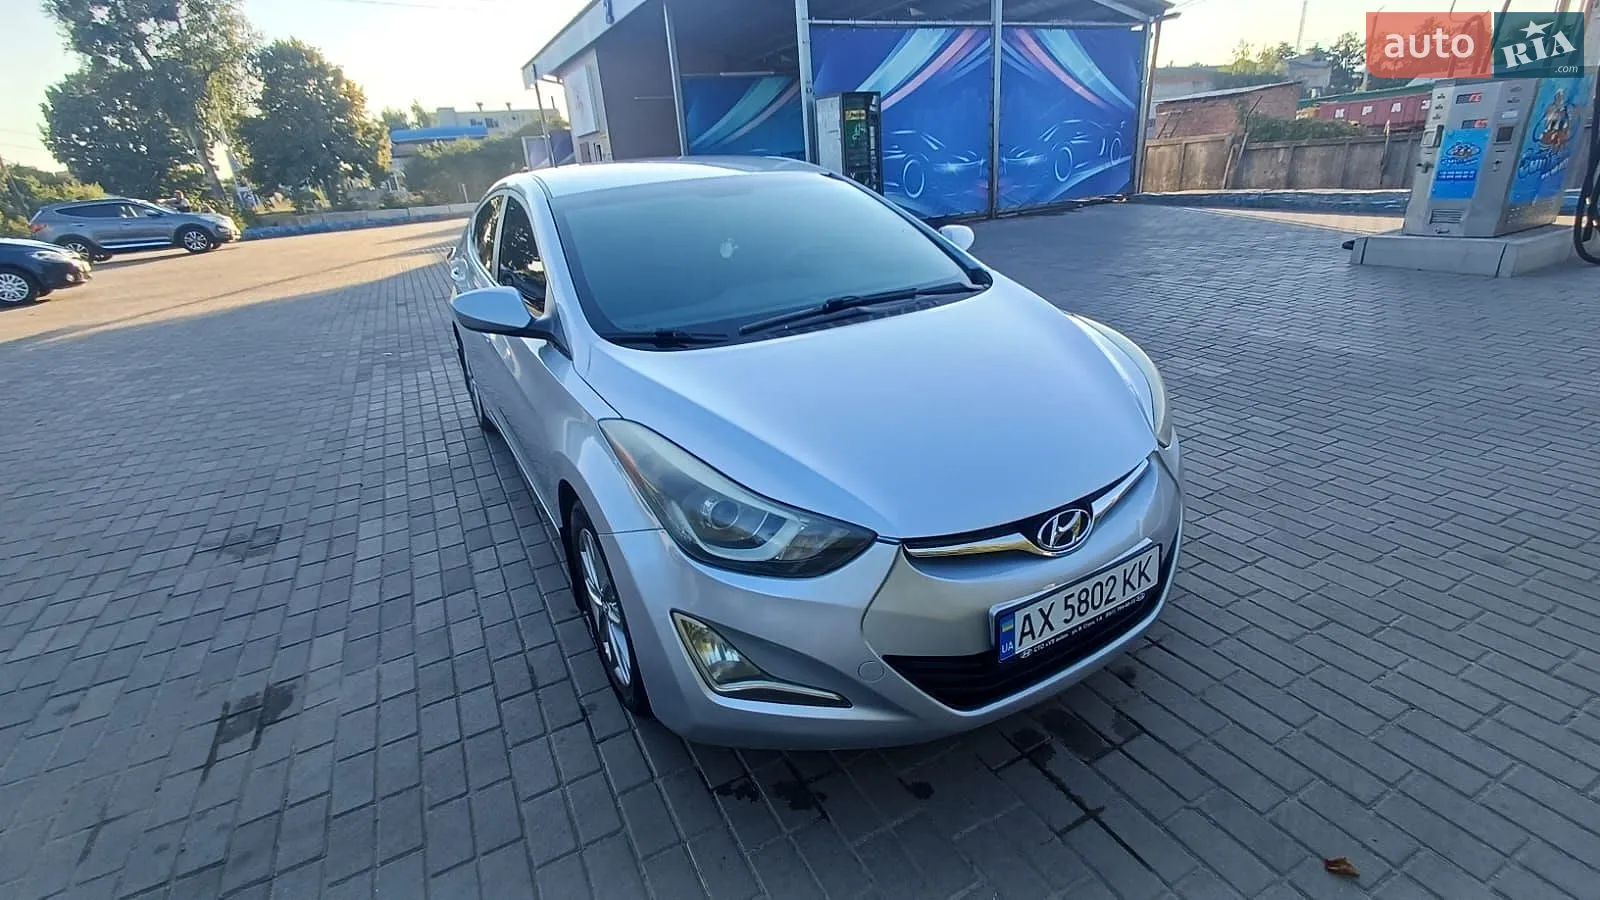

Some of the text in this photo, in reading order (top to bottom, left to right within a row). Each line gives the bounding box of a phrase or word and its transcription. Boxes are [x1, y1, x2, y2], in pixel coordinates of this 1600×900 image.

[1018, 602, 1055, 647] AX
[1063, 575, 1117, 624] 5802
[1122, 555, 1153, 597] KK
[1001, 640, 1014, 654] UA
